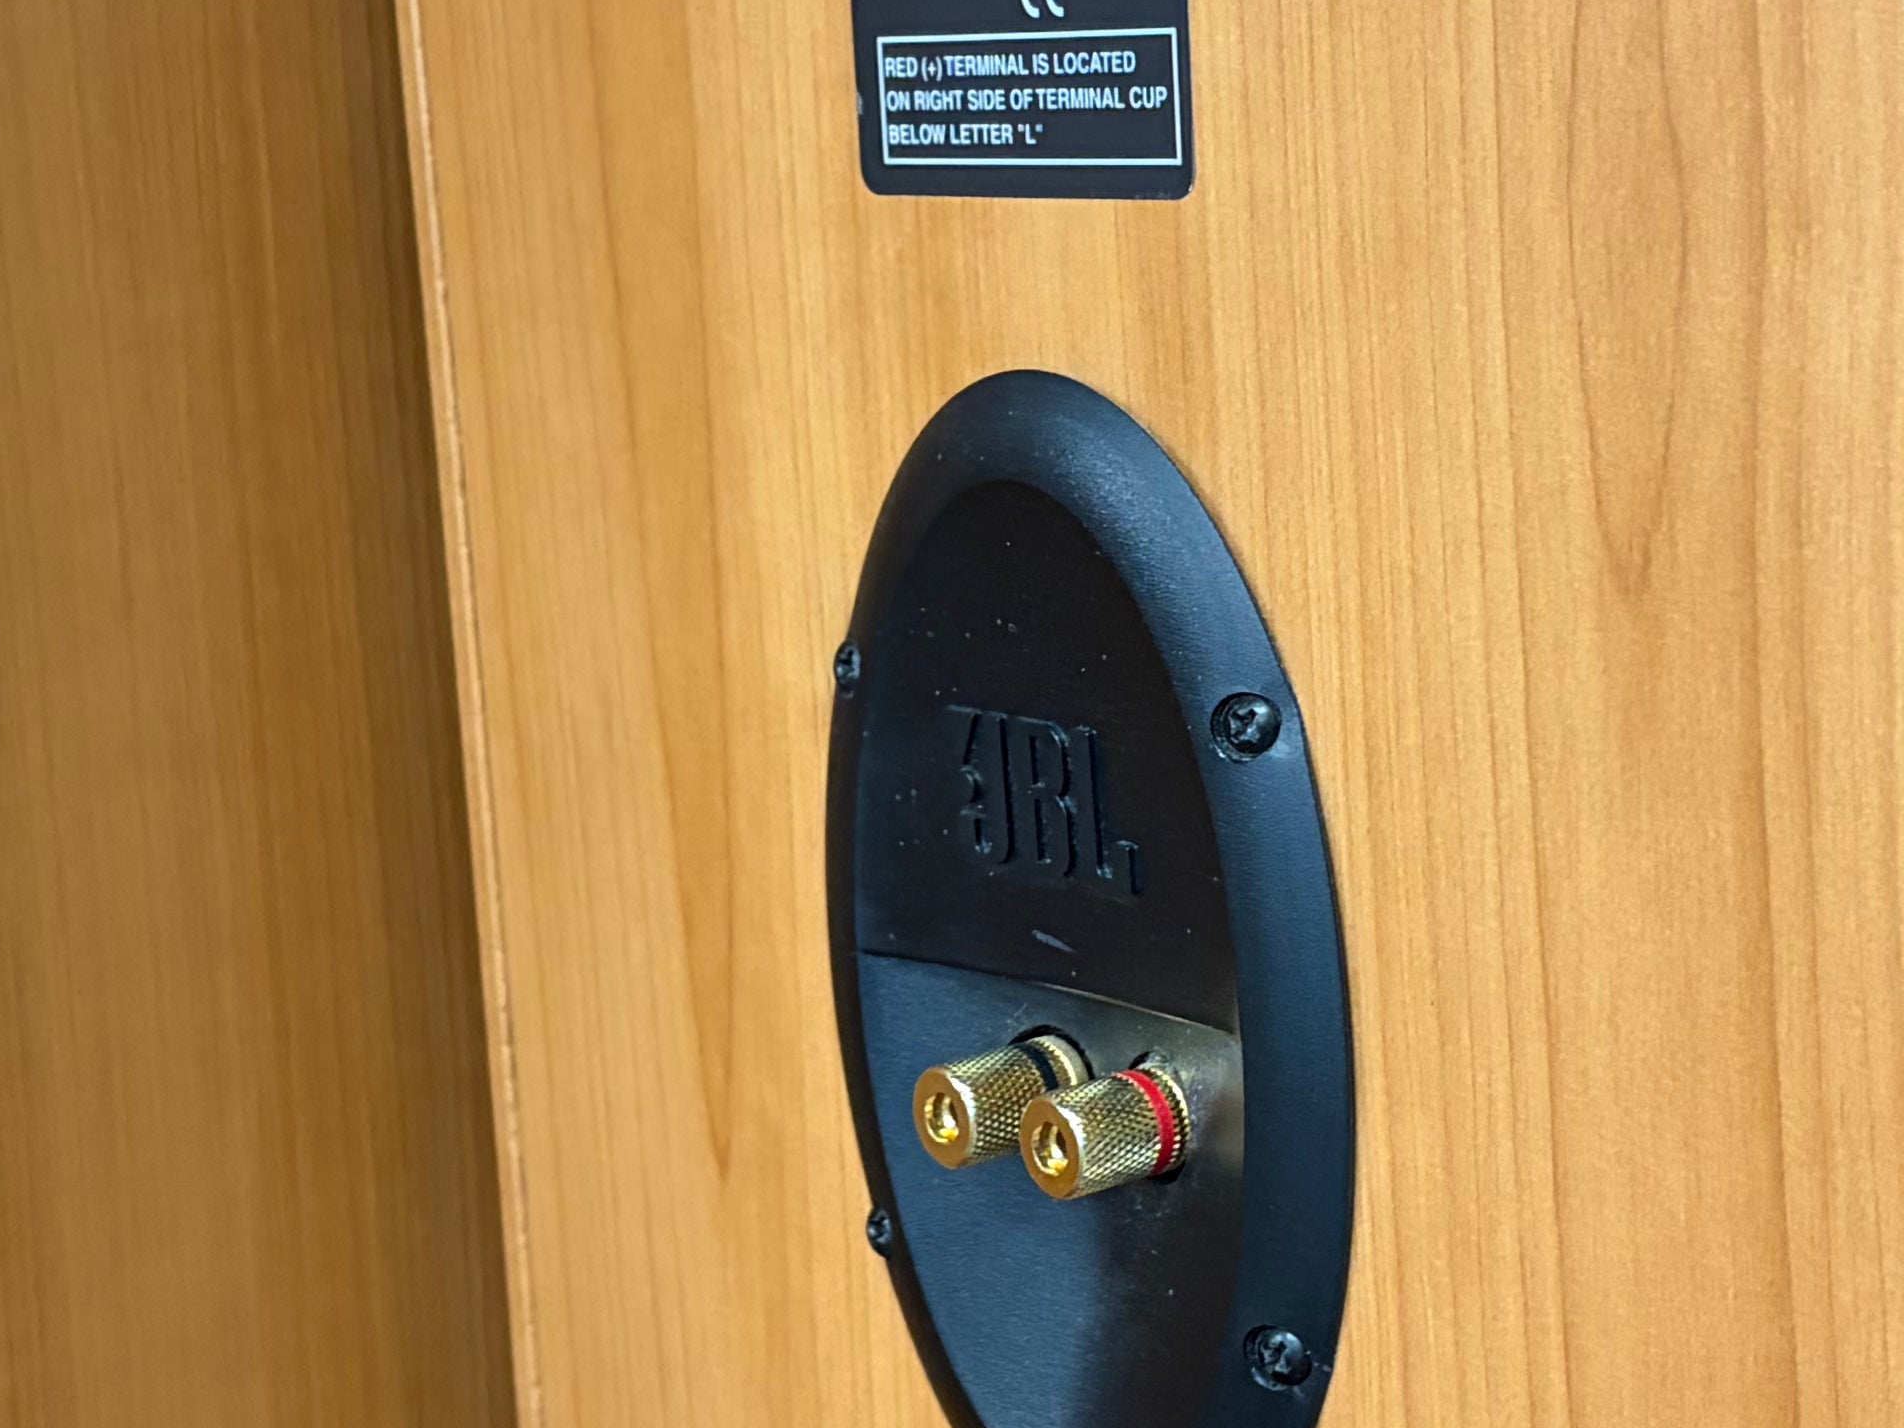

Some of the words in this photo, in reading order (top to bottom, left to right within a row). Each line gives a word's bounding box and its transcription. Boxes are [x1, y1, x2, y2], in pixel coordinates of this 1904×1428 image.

[884, 56, 918, 78] RED
[921, 56, 943, 82] (+)
[943, 53, 1029, 77] TERMINAL
[1032, 52, 1049, 75] IS
[1053, 51, 1137, 74] LOCATED
[886, 90, 911, 111] ON
[914, 89, 963, 111] RIGHT
[967, 89, 1006, 111] SIDE
[1009, 88, 1033, 111] OF
[1035, 87, 1126, 110] TERMINAL
[1129, 86, 1168, 109] CUP
[888, 124, 946, 145] BELOW
[949, 123, 1013, 145] LETTER
[1017, 123, 1044, 145] "L"
[945, 702, 1142, 898] JBL
